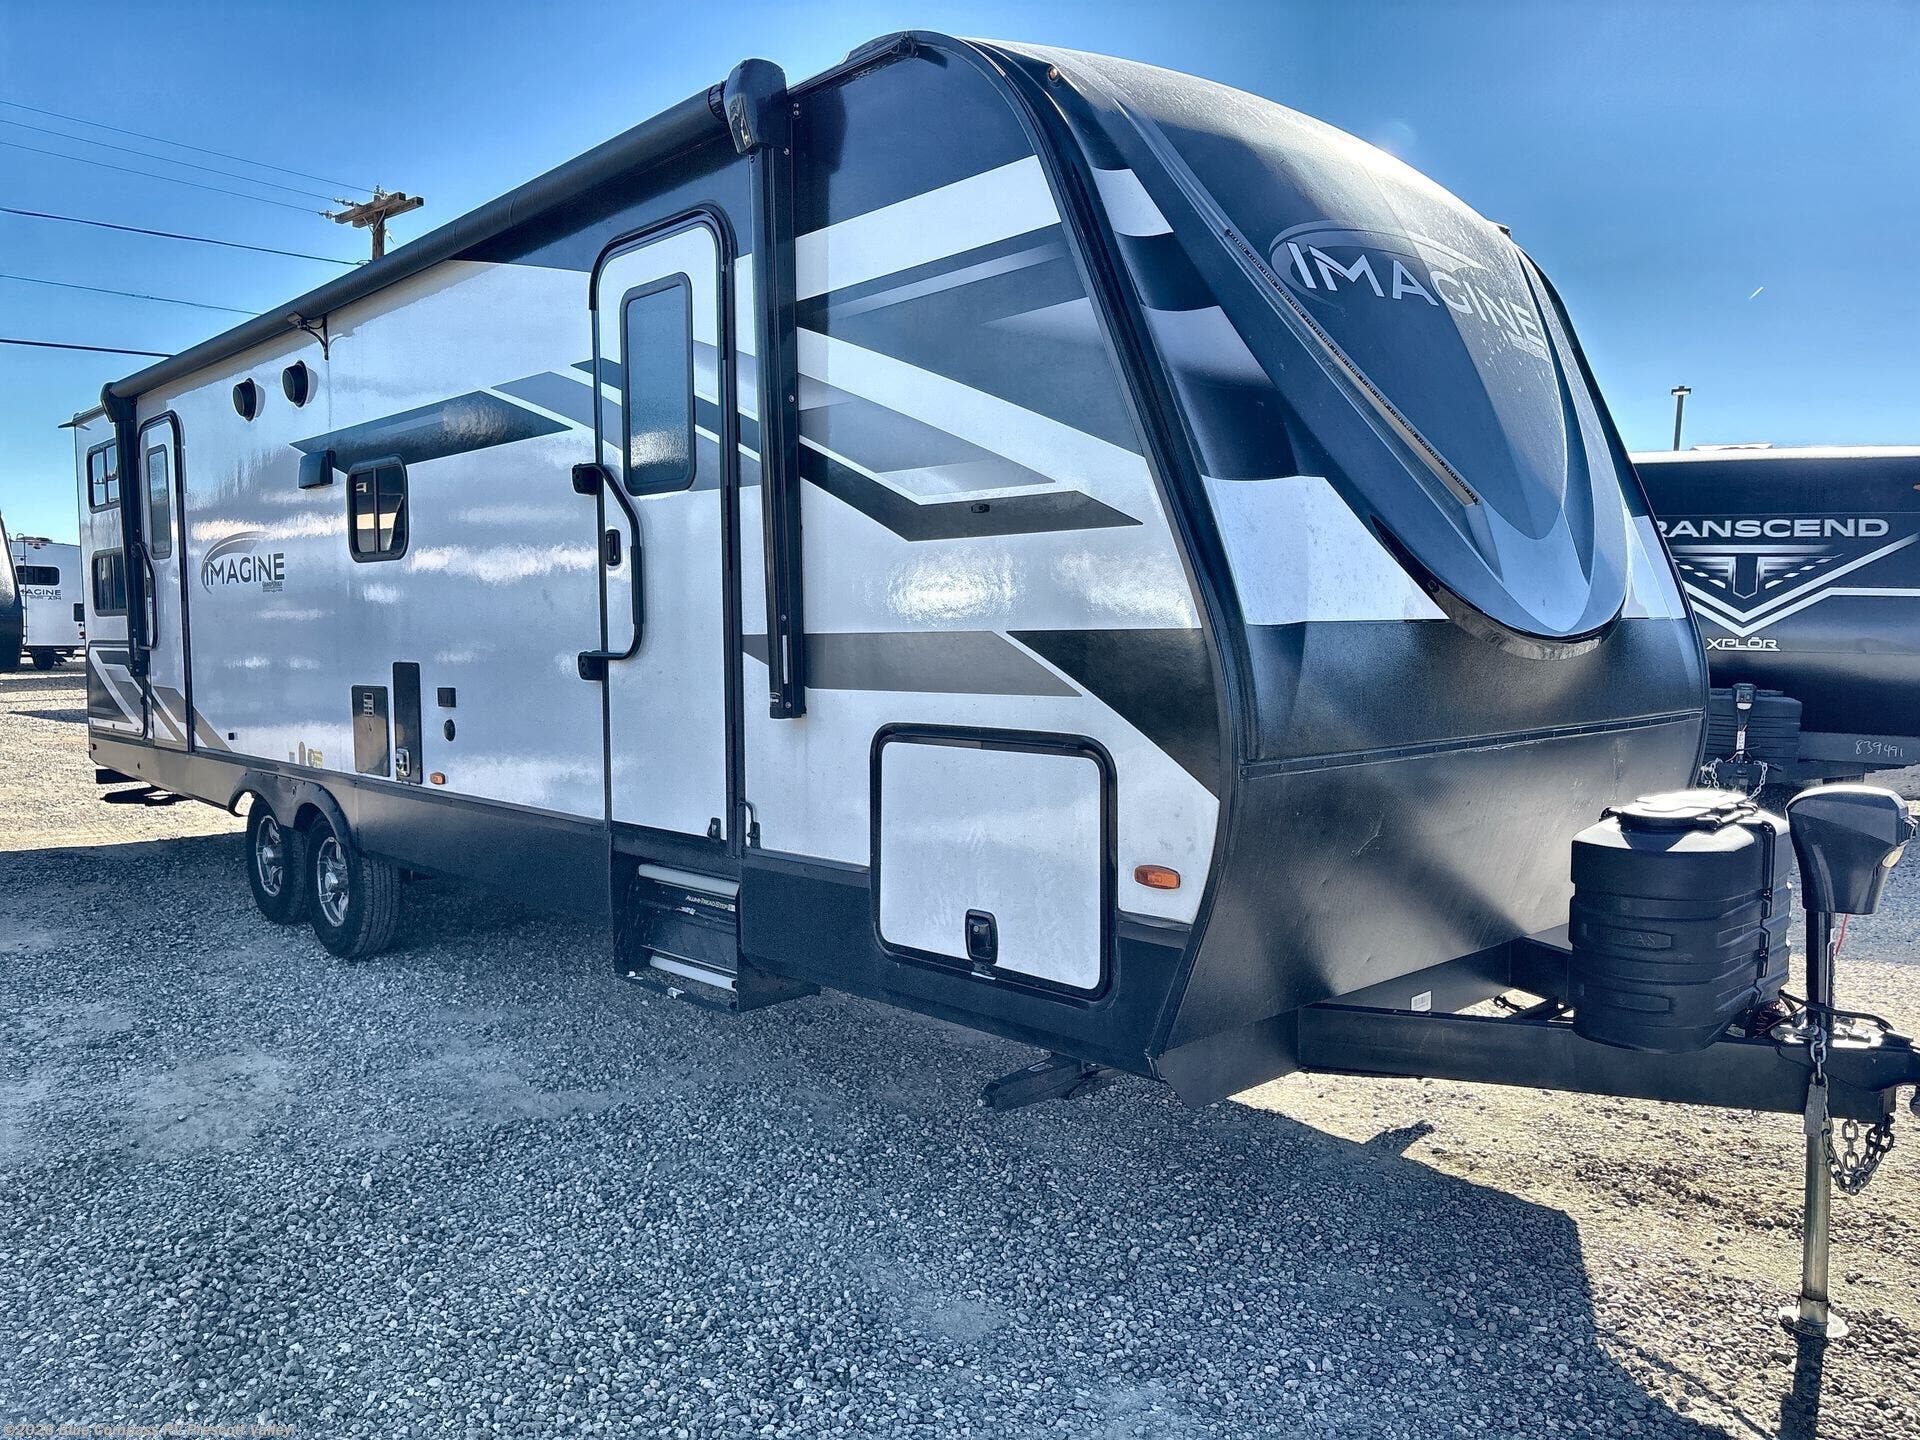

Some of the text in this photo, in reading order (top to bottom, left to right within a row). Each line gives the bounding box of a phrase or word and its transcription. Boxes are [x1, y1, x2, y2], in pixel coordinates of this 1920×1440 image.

[1286, 240, 1548, 350] IMAGINE
[1656, 518, 1890, 538] RANSCEND
[205, 552, 285, 586] IMAGINE
[20, 588, 62, 596] AGINE
[1855, 739, 1904, 758] 839491
